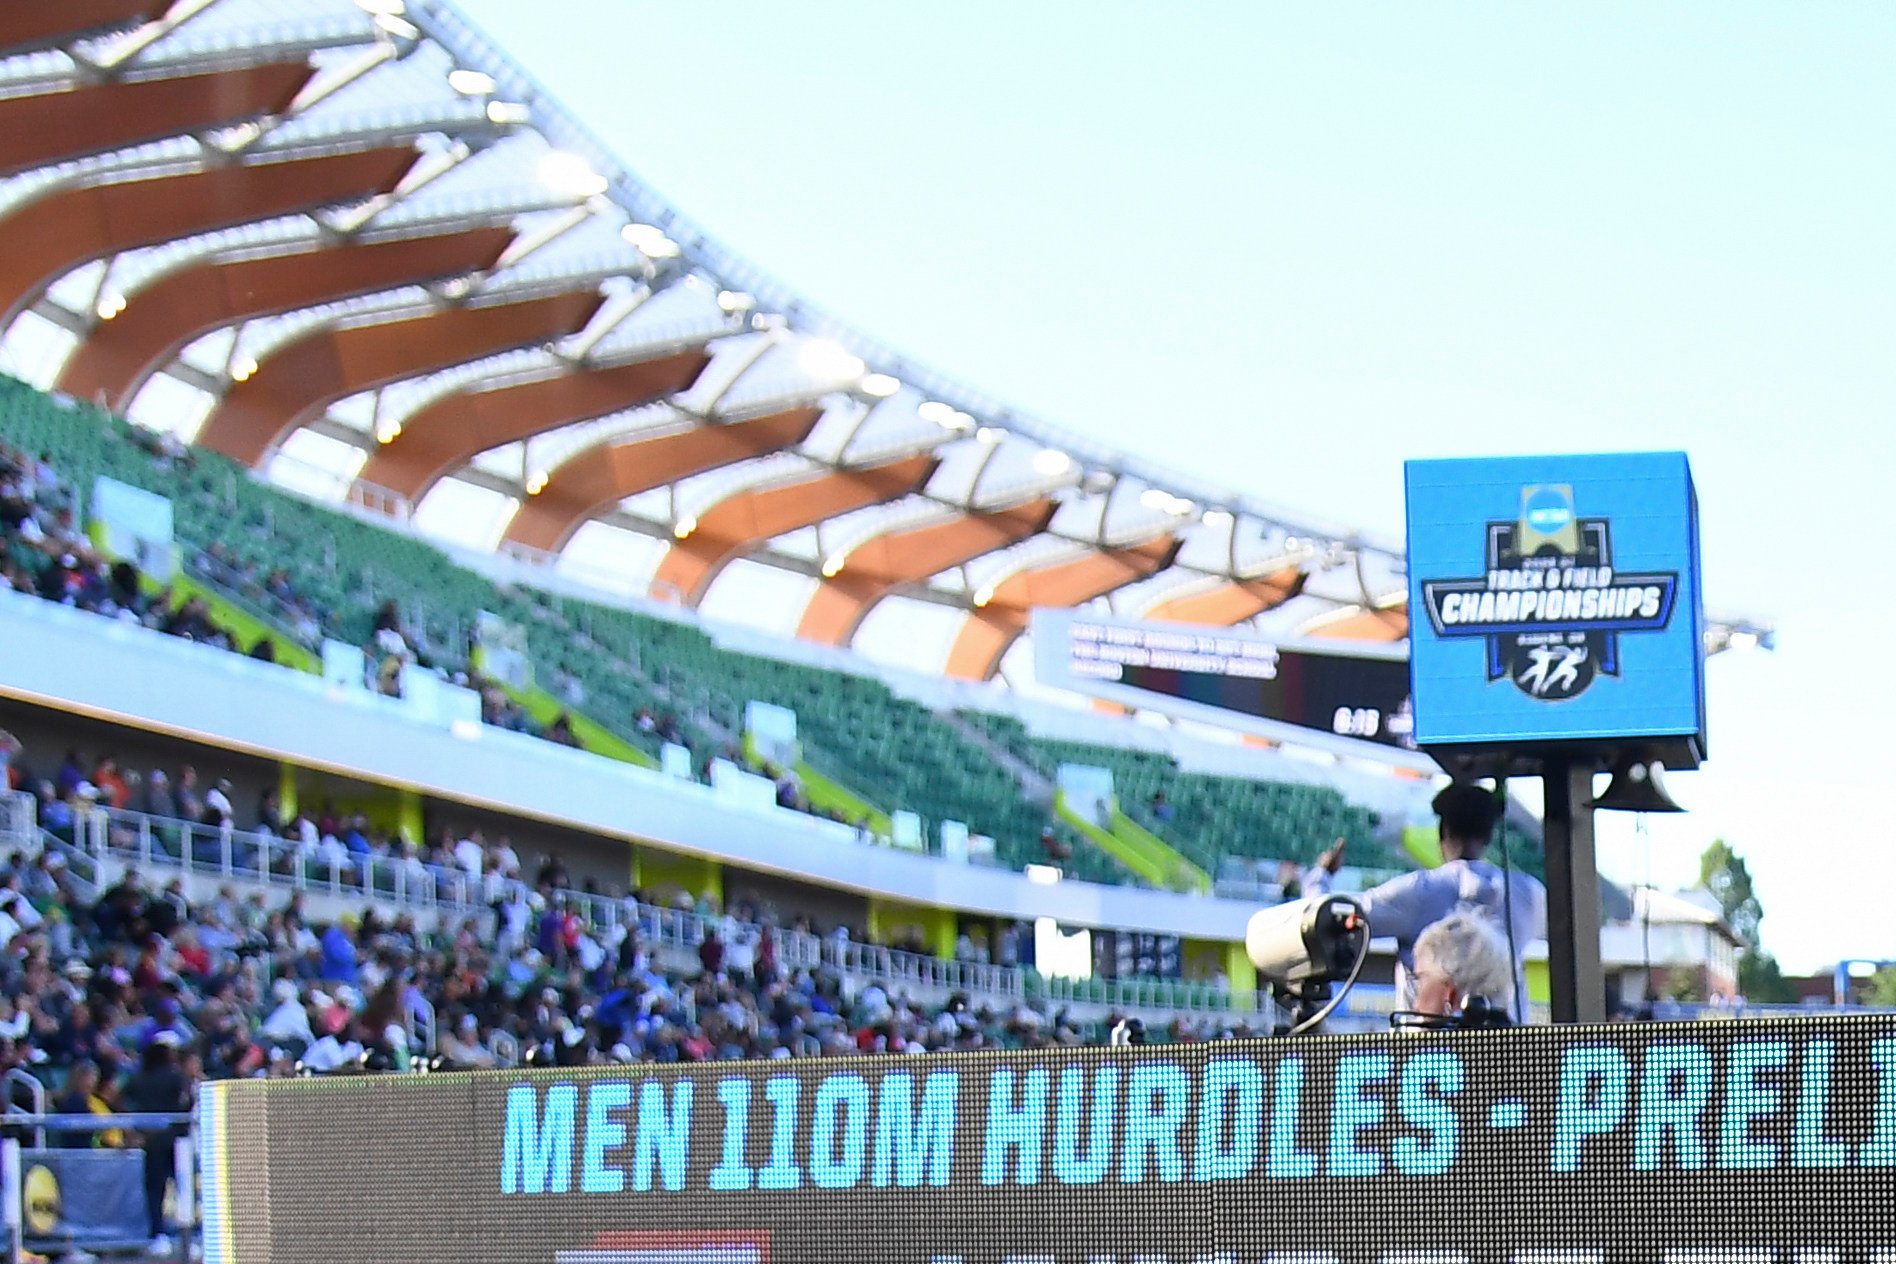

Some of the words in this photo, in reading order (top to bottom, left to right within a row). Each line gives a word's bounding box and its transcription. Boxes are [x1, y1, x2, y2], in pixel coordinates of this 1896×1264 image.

[1441, 585, 1661, 625] CHAMPIONSHIPS
[501, 1076, 693, 1194] MEN
[709, 1065, 960, 1190] 110M
[981, 1047, 1465, 1187] HURDLES
